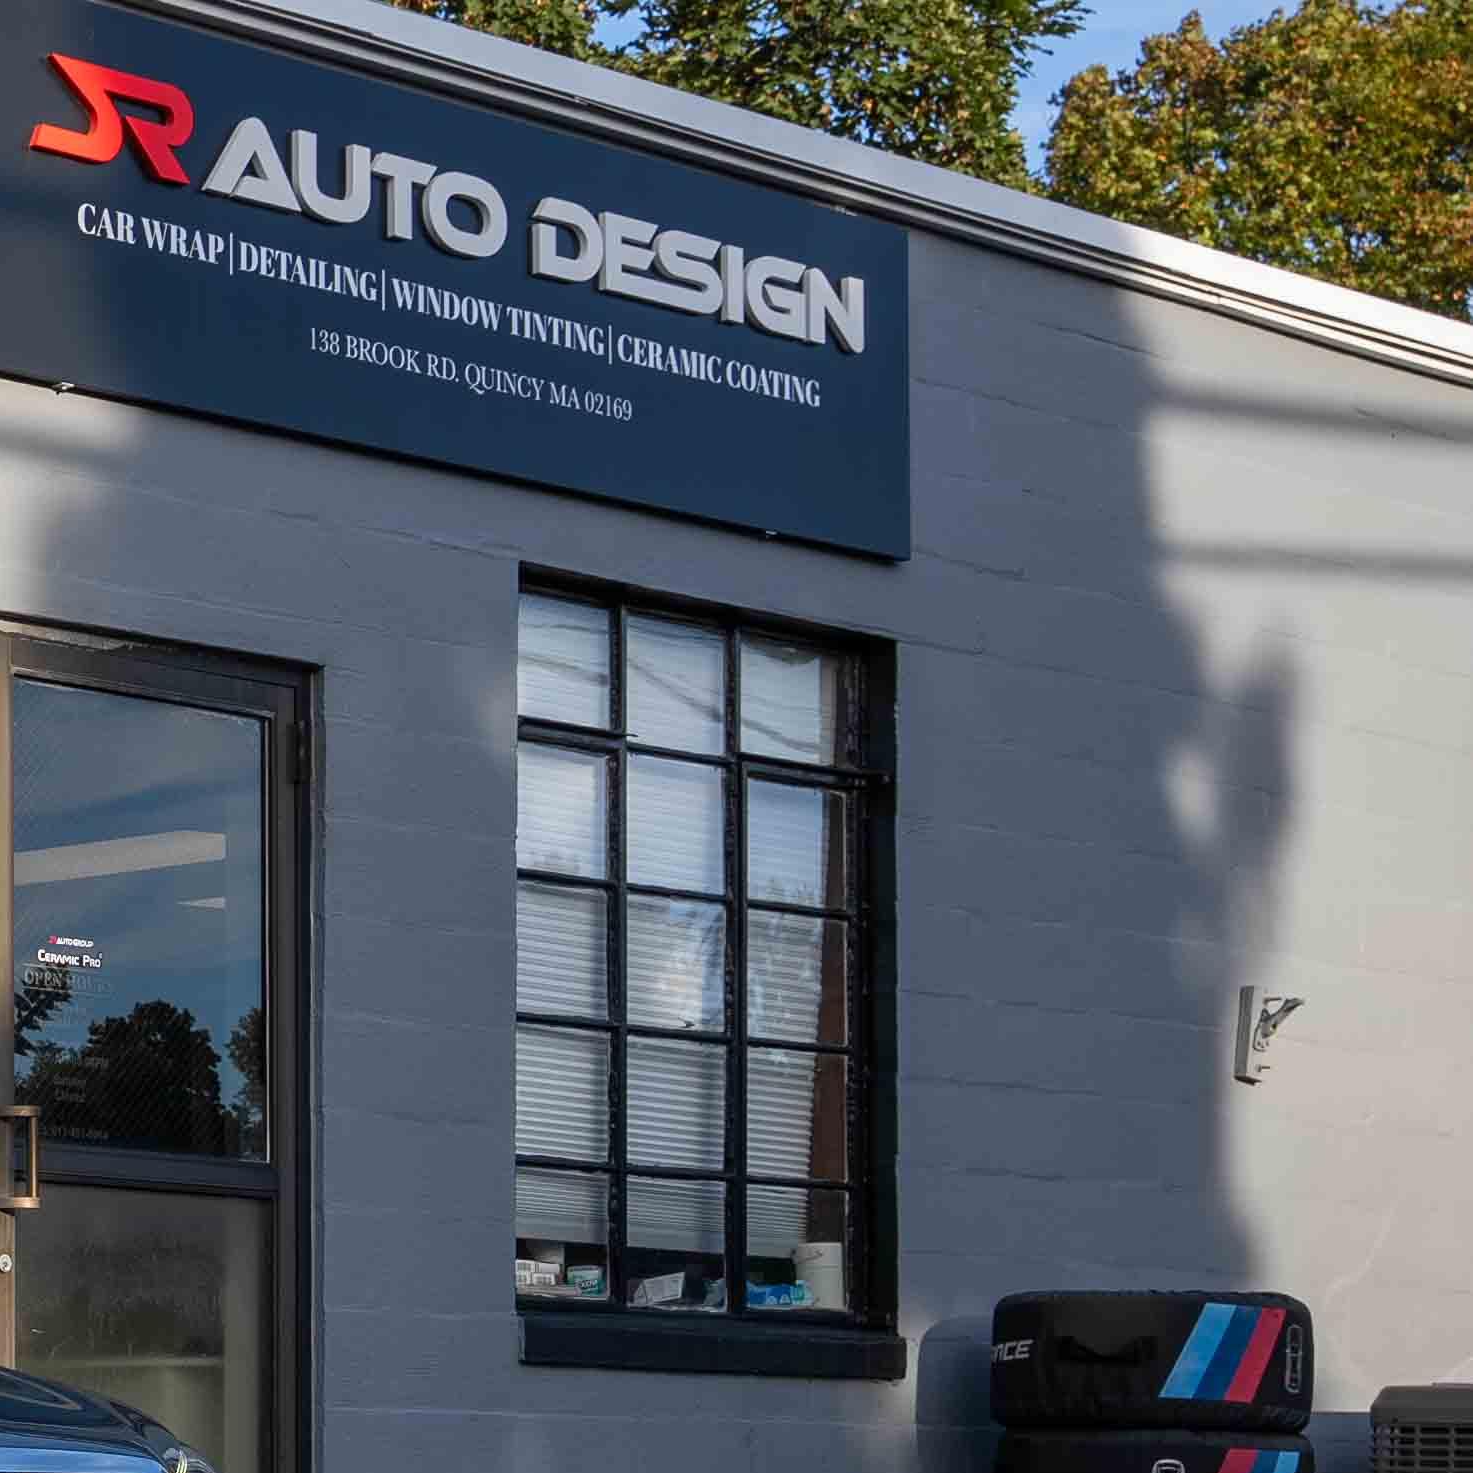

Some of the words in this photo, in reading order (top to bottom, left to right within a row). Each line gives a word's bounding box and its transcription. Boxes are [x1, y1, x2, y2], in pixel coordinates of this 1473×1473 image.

[202, 117, 508, 257] AUTO
[532, 196, 865, 353] DESIGN
[77, 203, 135, 244] CAR
[726, 360, 821, 408] COATING
[310, 327, 341, 355] 138
[346, 335, 422, 374] BROOK
[427, 354, 459, 382] RD.
[465, 363, 545, 395] QUINCY
[549, 382, 581, 410] MA
[584, 391, 633, 421] 02169
[24, 967, 63, 987] OPEN
[37, 948, 80, 966] CERAMIC
